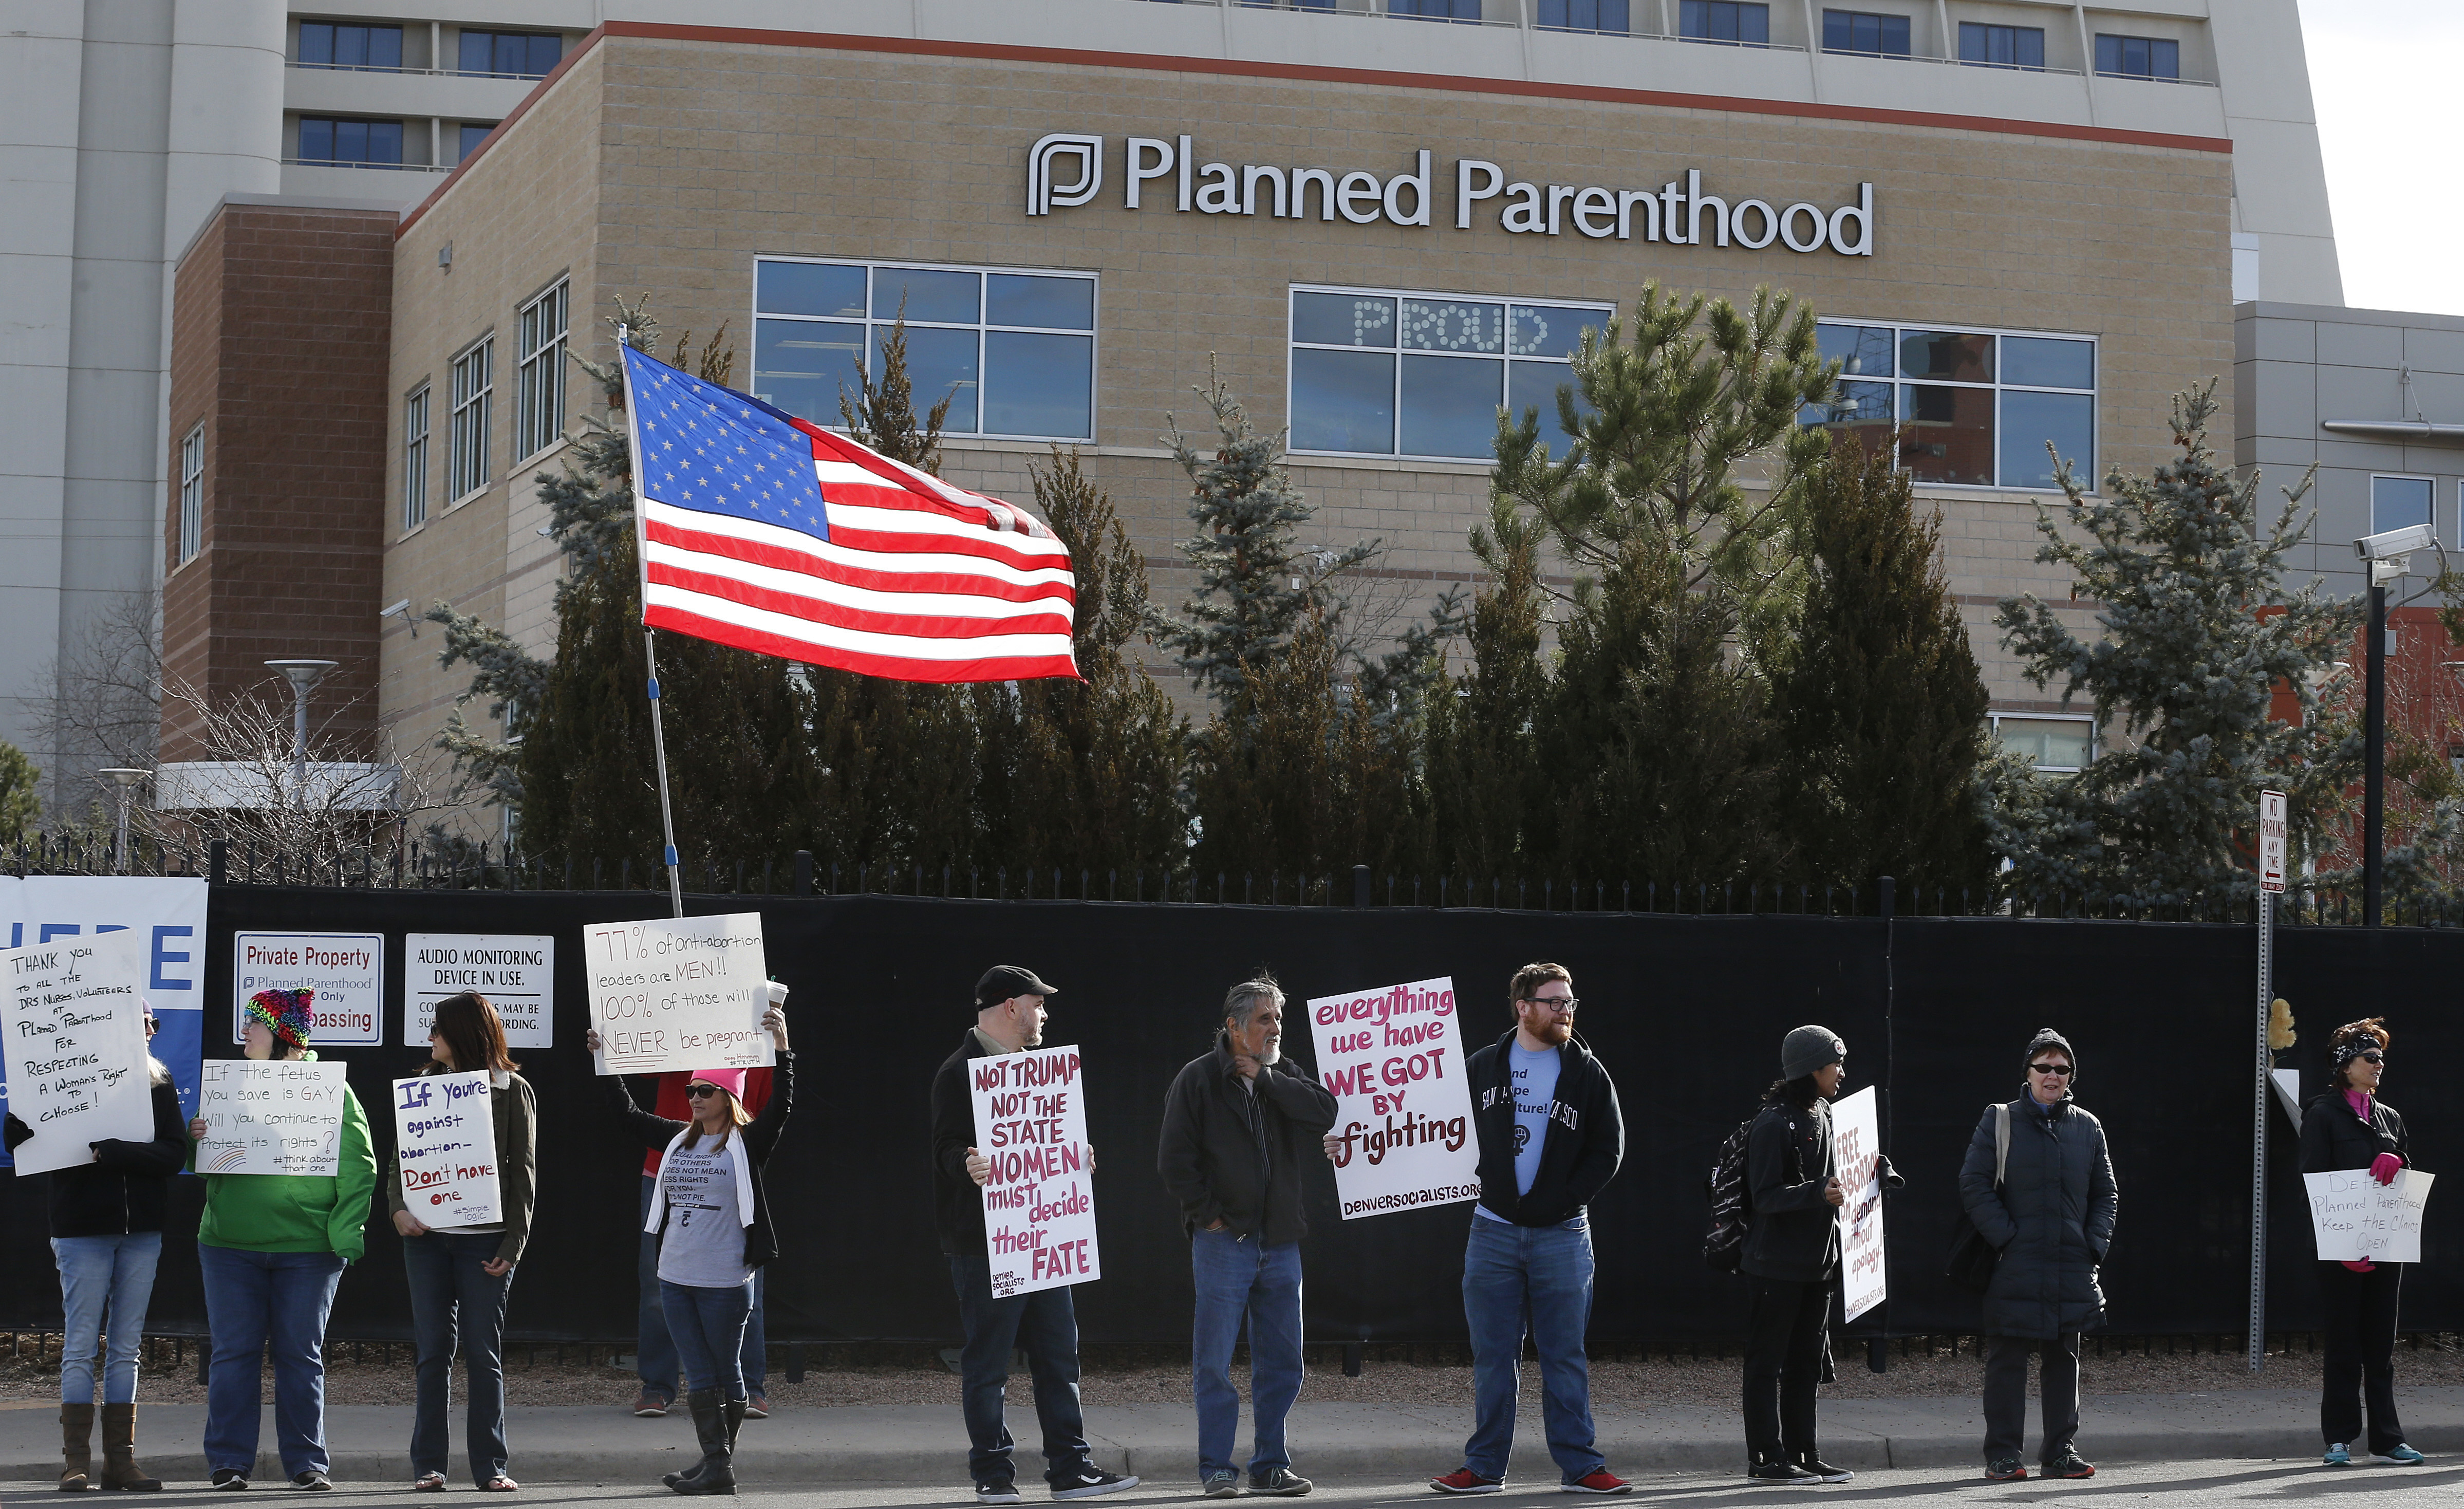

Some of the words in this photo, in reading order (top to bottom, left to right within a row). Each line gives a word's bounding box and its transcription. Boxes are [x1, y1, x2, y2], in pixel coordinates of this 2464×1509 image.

[1125, 134, 1431, 227] Planned
[1455, 159, 1873, 256] Parenthood
[1355, 301, 1547, 355] PROUD
[2270, 798, 2278, 816] NO
[2263, 818, 2284, 839] PARKING
[2268, 841, 2278, 853] ANY
[2267, 855, 2278, 868] TIME
[595, 926, 648, 961] 77%
[656, 933, 671, 955] of
[676, 933, 761, 952] anti-abortion
[10, 952, 59, 974] THANK
[247, 946, 298, 965] Private
[306, 947, 370, 970] Property
[418, 949, 458, 964] AUDIO
[463, 950, 543, 966] MONITORING
[16, 985, 30, 993] TO
[36, 980, 52, 989] ALL
[60, 975, 81, 984] THE
[258, 977, 304, 989] Planned
[435, 970, 477, 985] DEVICE
[482, 971, 495, 985] IN
[500, 971, 525, 986] USE.
[596, 973, 645, 989] leaders
[649, 973, 671, 983] are
[676, 956, 726, 982] MEN!!
[18, 997, 39, 1010] DRS
[321, 992, 345, 1002] Only
[503, 1003, 524, 1014] MAY
[528, 1004, 539, 1014] BE
[600, 992, 652, 1021] 100%
[661, 993, 678, 1010] of
[682, 992, 720, 1007] those
[726, 989, 750, 1002] will
[1316, 985, 1454, 1026] everything
[53, 1007, 64, 1015] AT
[501, 1019, 539, 1030] ORDING.
[602, 1030, 668, 1058] NEVER
[679, 1029, 702, 1049] be
[706, 1028, 762, 1050] pregnant
[1331, 1031, 1373, 1054] we
[1385, 1021, 1444, 1048] have
[204, 1064, 230, 1081] If
[239, 1064, 271, 1079] the
[278, 1065, 321, 1082] fetus
[976, 1060, 1011, 1093] NOT
[1011, 1053, 1081, 1089] TRUMP
[1324, 1063, 1378, 1097] WE
[1382, 1048, 1445, 1086] GOT
[1511, 1069, 1528, 1078] nd
[40, 1083, 48, 1095] A
[204, 1090, 228, 1105] you
[237, 1090, 270, 1101] save
[283, 1089, 293, 1100] is
[301, 1085, 337, 1103] GAY,
[397, 1080, 433, 1109] If
[1482, 1086, 1497, 1111] SAN
[991, 1090, 1032, 1120] NOT
[1033, 1093, 1068, 1118] THE
[1373, 1090, 1406, 1115] BY
[1514, 1101, 1547, 1114] lture!
[202, 1113, 223, 1127] Will
[232, 1113, 254, 1131] you
[264, 1113, 318, 1125] continue
[320, 1114, 337, 1124] to
[407, 1114, 463, 1138] against
[991, 1118, 1066, 1148] STATE
[201, 1137, 245, 1149] Protect
[252, 1137, 268, 1147] its
[1335, 1111, 1466, 1168] fighting
[1836, 1126, 1860, 1167] FREE
[402, 1163, 450, 1187] Don't
[455, 1163, 495, 1180] have
[986, 1141, 1080, 1186] WOMEN
[1840, 1148, 1879, 1197] ABORTION
[431, 1191, 462, 1205] one
[987, 1177, 1039, 1211] must
[1029, 1181, 1089, 1223] decide
[464, 1212, 486, 1221] logic
[1841, 1200, 1851, 1222] on
[1851, 1194, 1880, 1226] demand
[1844, 1216, 1873, 1254] without
[2322, 1217, 2354, 1232] Keep
[2391, 1214, 2418, 1233] Clinics
[992, 1224, 1048, 1256] their
[1032, 1239, 1090, 1280] FATE
[1852, 1227, 1882, 1283] apology!
[992, 1278, 1025, 1291] SOCIALISTS
[998, 1288, 1015, 1296] .ORG
